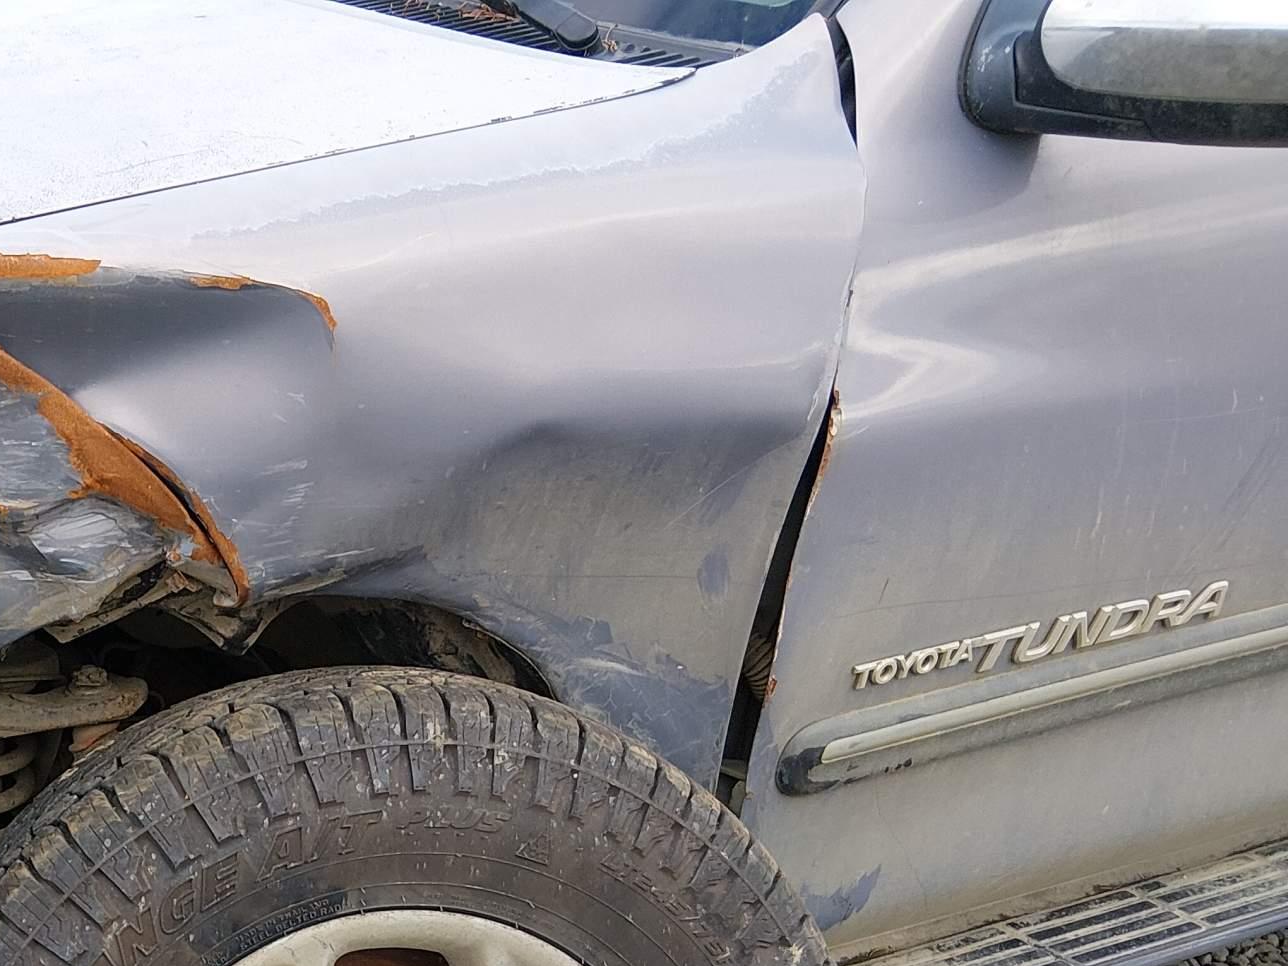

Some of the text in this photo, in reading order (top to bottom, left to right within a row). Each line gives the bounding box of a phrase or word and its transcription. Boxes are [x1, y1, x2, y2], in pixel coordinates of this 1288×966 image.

[852, 580, 1229, 690] TOYOTA TUNDRA
[257, 809, 385, 883] A/T
[395, 808, 513, 834] PLUS
